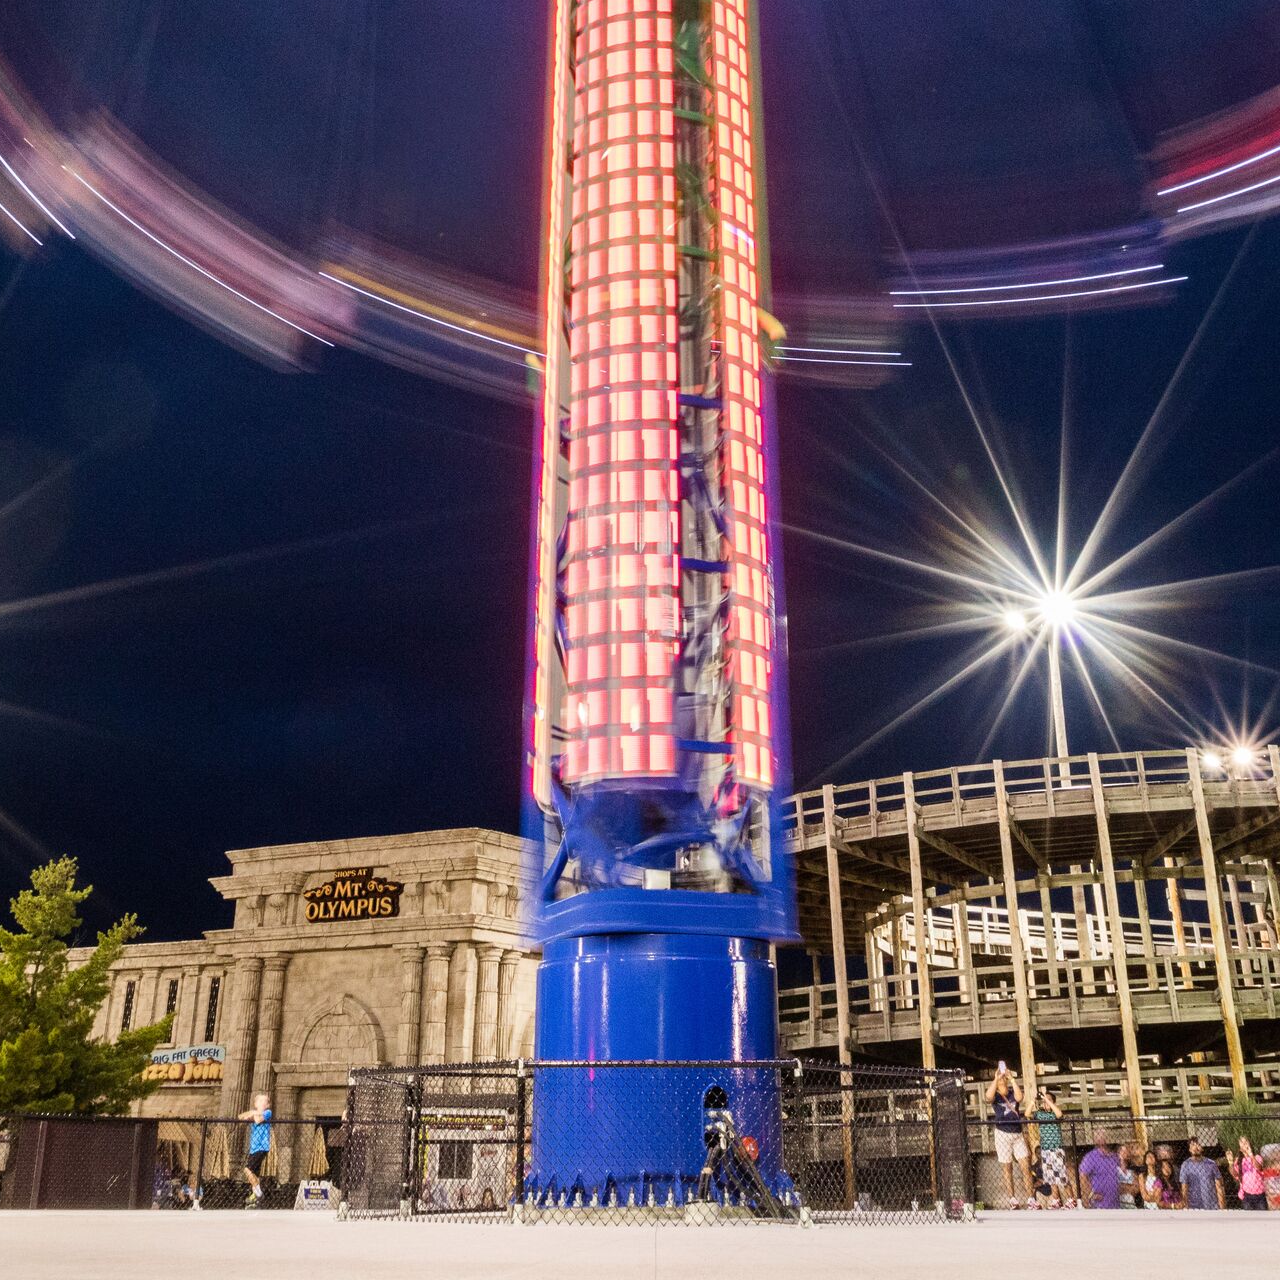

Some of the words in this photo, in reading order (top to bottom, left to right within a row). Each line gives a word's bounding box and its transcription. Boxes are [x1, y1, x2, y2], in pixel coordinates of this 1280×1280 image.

[334, 870, 356, 878] SHOPS
[305, 896, 392, 920] OLYMPUS
[153, 1054, 169, 1064] BIG
[172, 1051, 187, 1061] FAT
[189, 1048, 220, 1058] GREEK
[141, 1060, 183, 1081] izza
